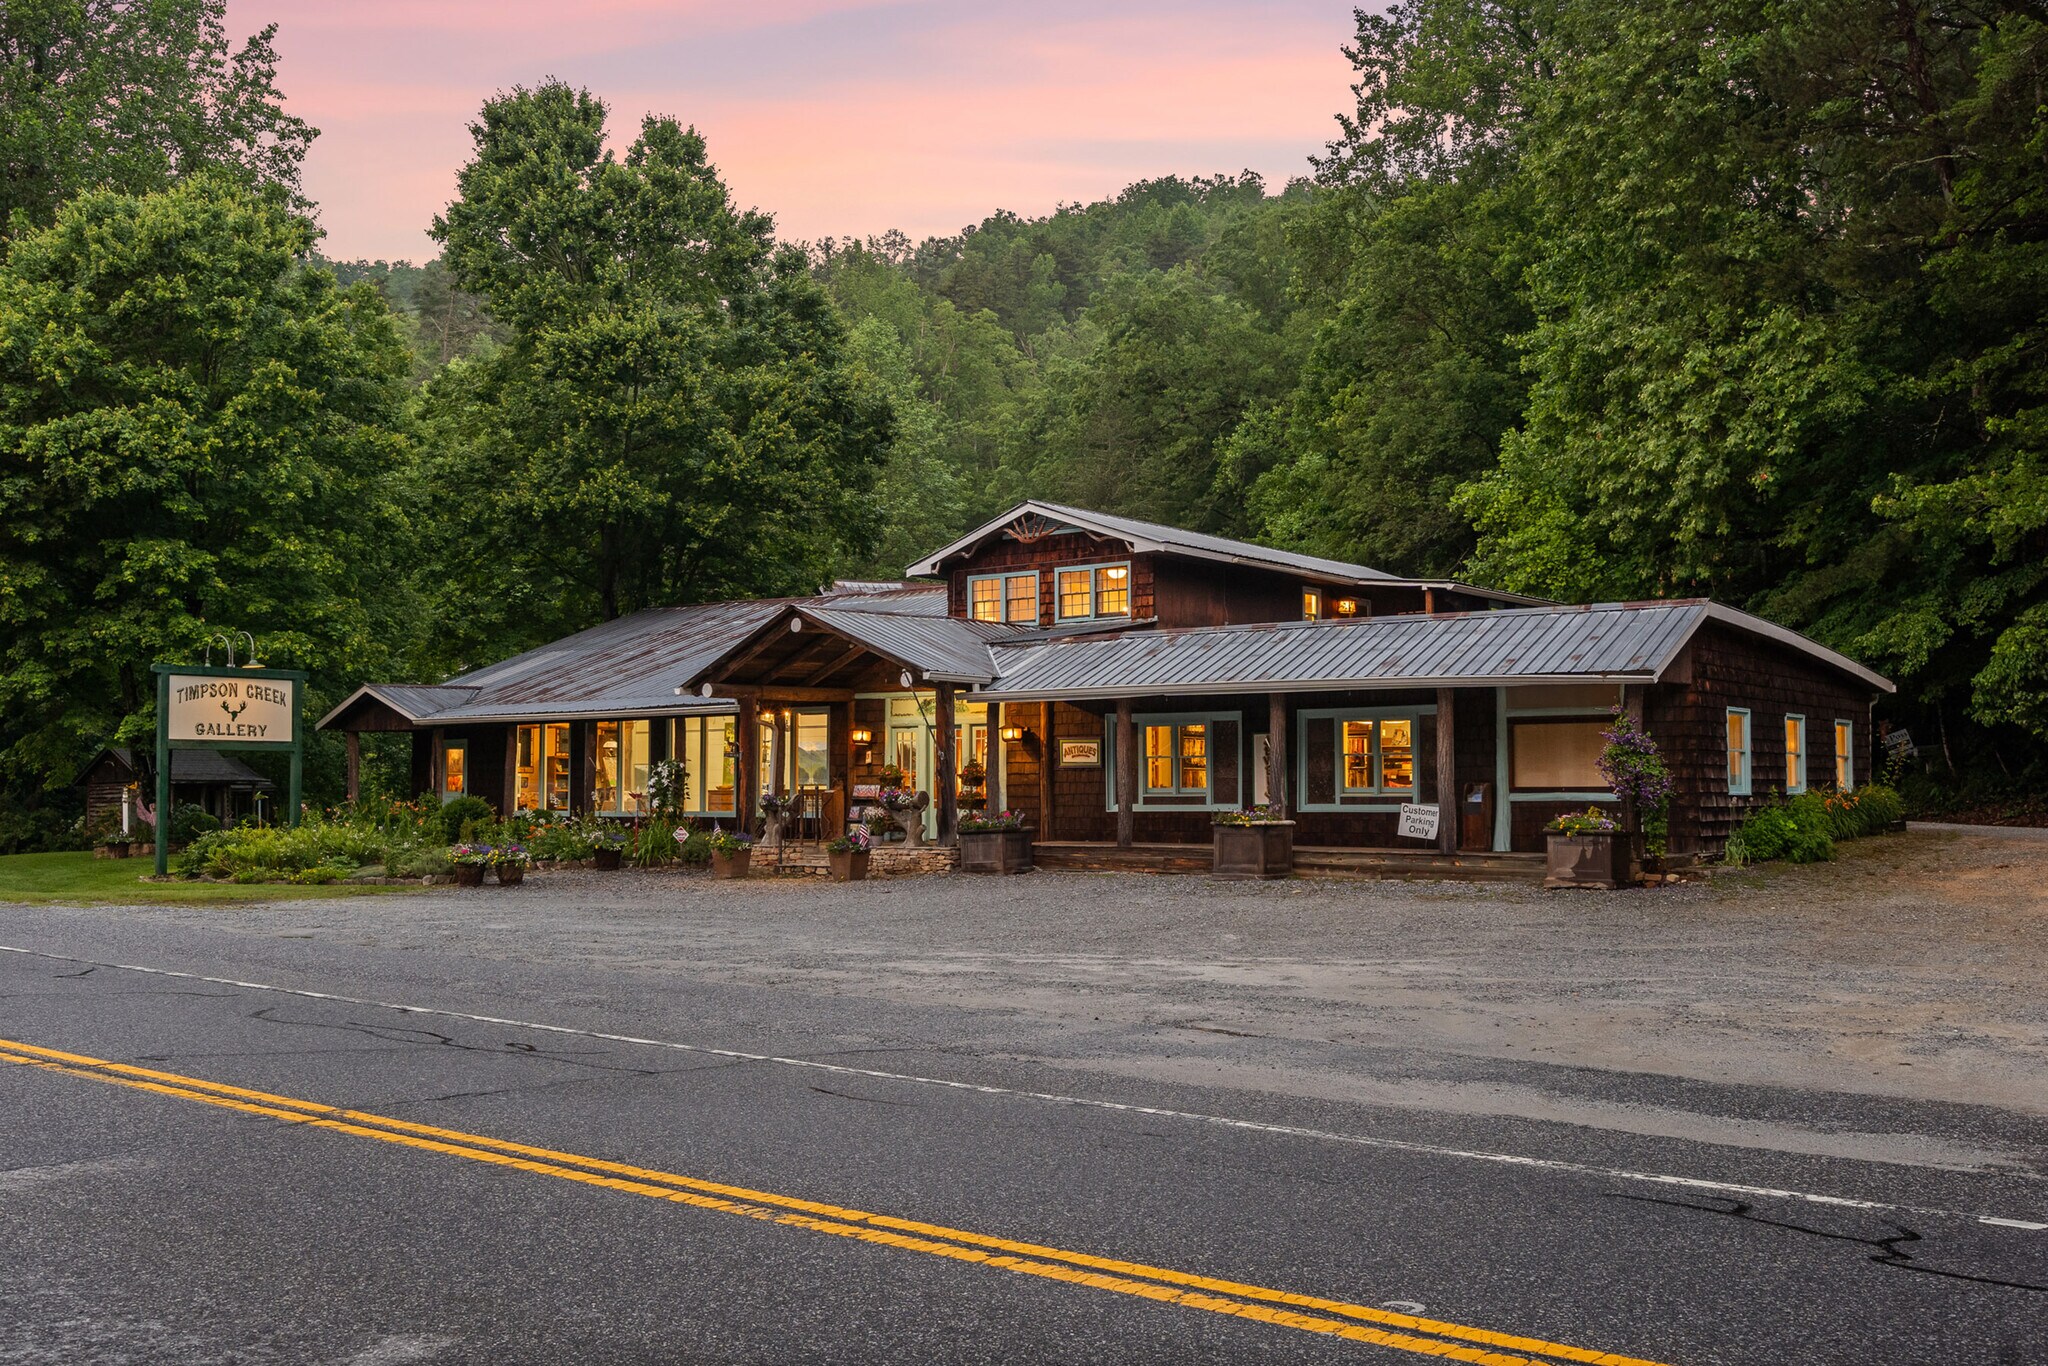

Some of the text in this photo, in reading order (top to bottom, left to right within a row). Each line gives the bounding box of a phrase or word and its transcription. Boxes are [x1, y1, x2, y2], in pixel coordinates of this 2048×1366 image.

[176, 682, 287, 708] TIMPSON CREEK
[194, 722, 268, 737] GALLERY
[1063, 745, 1097, 758] ANTIQUES
[1402, 805, 1439, 817] Customer
[1405, 815, 1435, 828] Parking
[1408, 825, 1430, 837] Only
